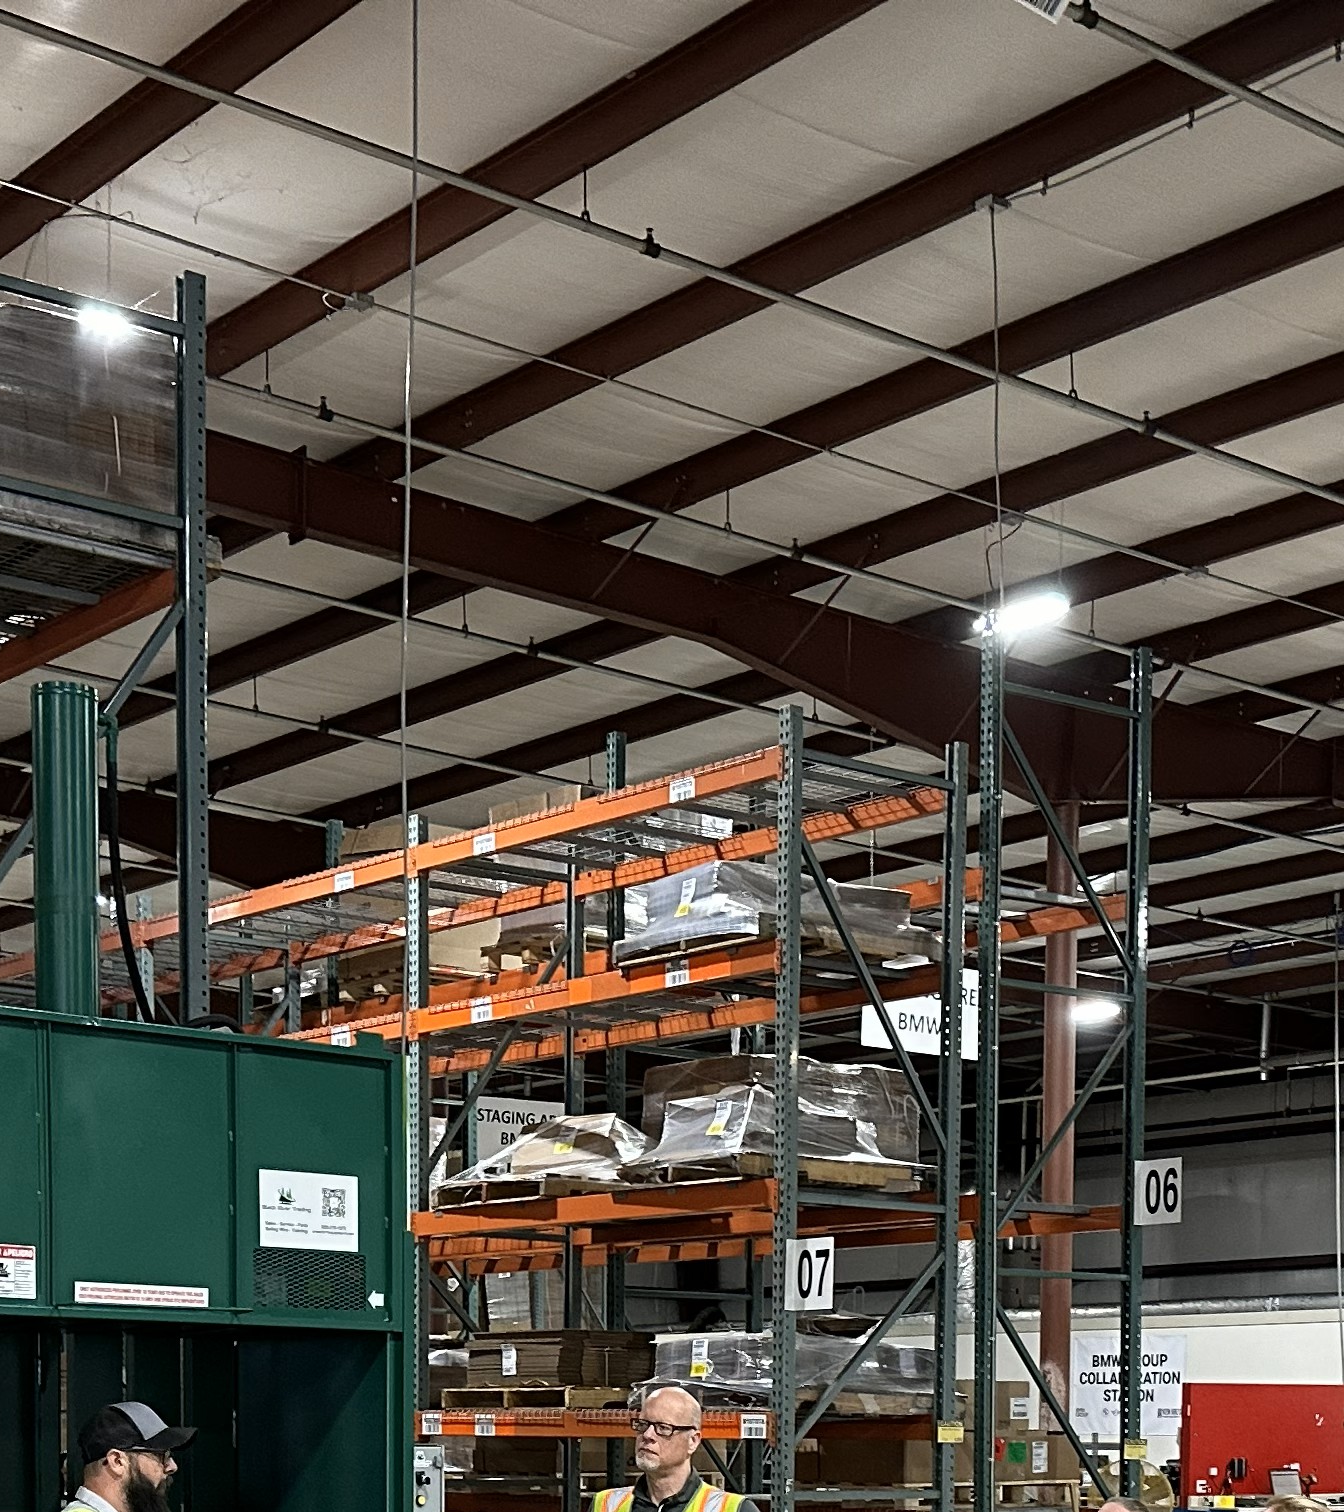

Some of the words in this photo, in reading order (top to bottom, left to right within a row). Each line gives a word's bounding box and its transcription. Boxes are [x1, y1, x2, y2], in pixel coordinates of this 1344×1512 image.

[899, 1012, 941, 1035] BMW
[477, 1108, 535, 1125] STAGING
[1145, 1167, 1179, 1215] 06
[797, 1249, 829, 1299] 07
[1092, 1355, 1121, 1367] BMW
[1079, 1371, 1181, 1384] COLLAATION
[1103, 1389, 1154, 1402] STON
